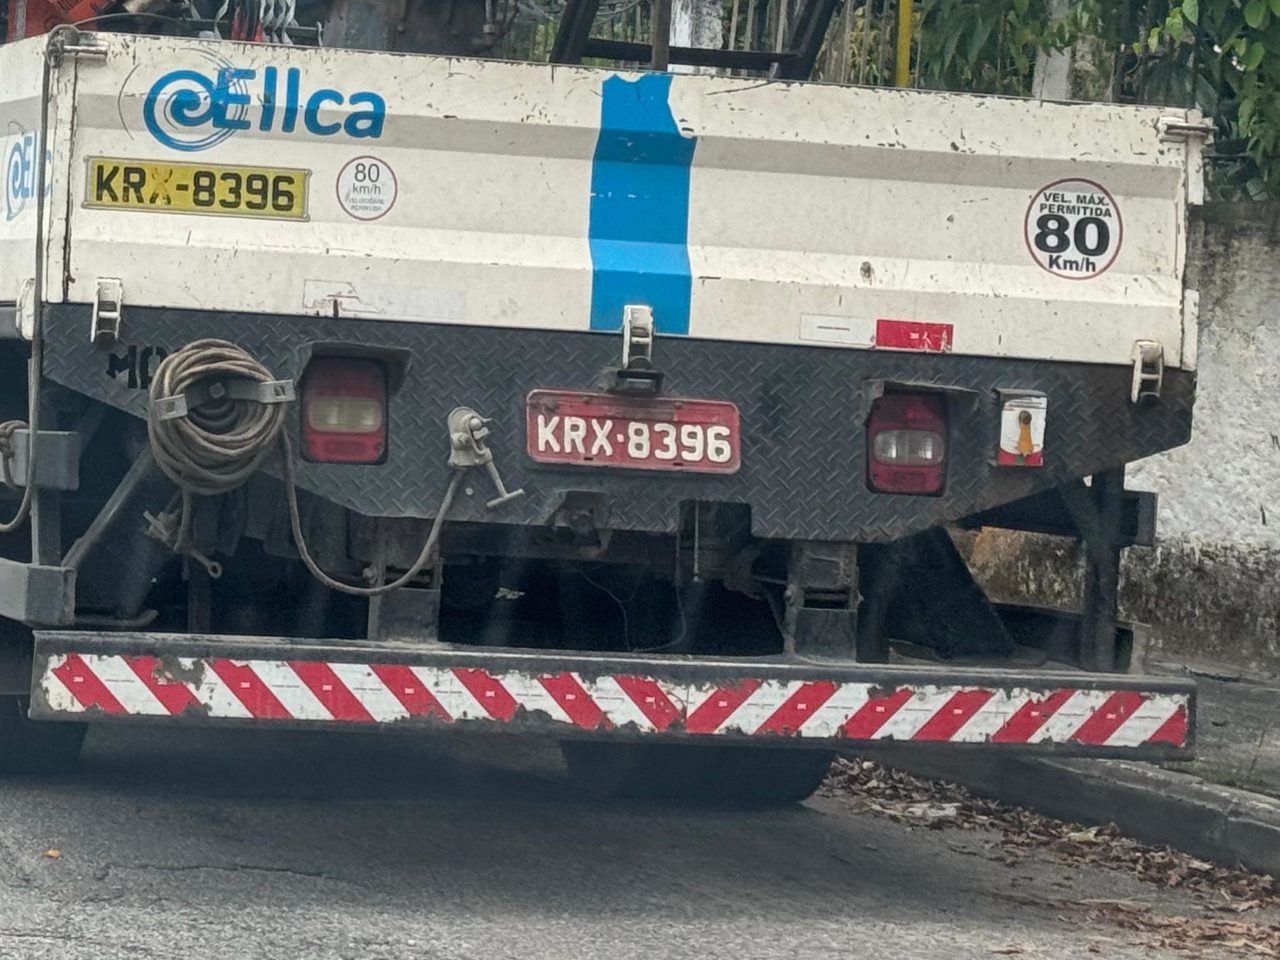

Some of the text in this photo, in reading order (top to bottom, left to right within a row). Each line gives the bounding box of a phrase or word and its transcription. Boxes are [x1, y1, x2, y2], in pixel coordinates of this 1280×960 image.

[354, 163, 380, 183] 80
[95, 164, 296, 212] KRX-8396
[352, 183, 382, 195] km/h
[1043, 192, 1110, 207] VEL. MÁX.
[1039, 203, 1113, 218] PERMITIDA
[1034, 213, 1111, 257] 80
[1048, 254, 1097, 273] Km/h
